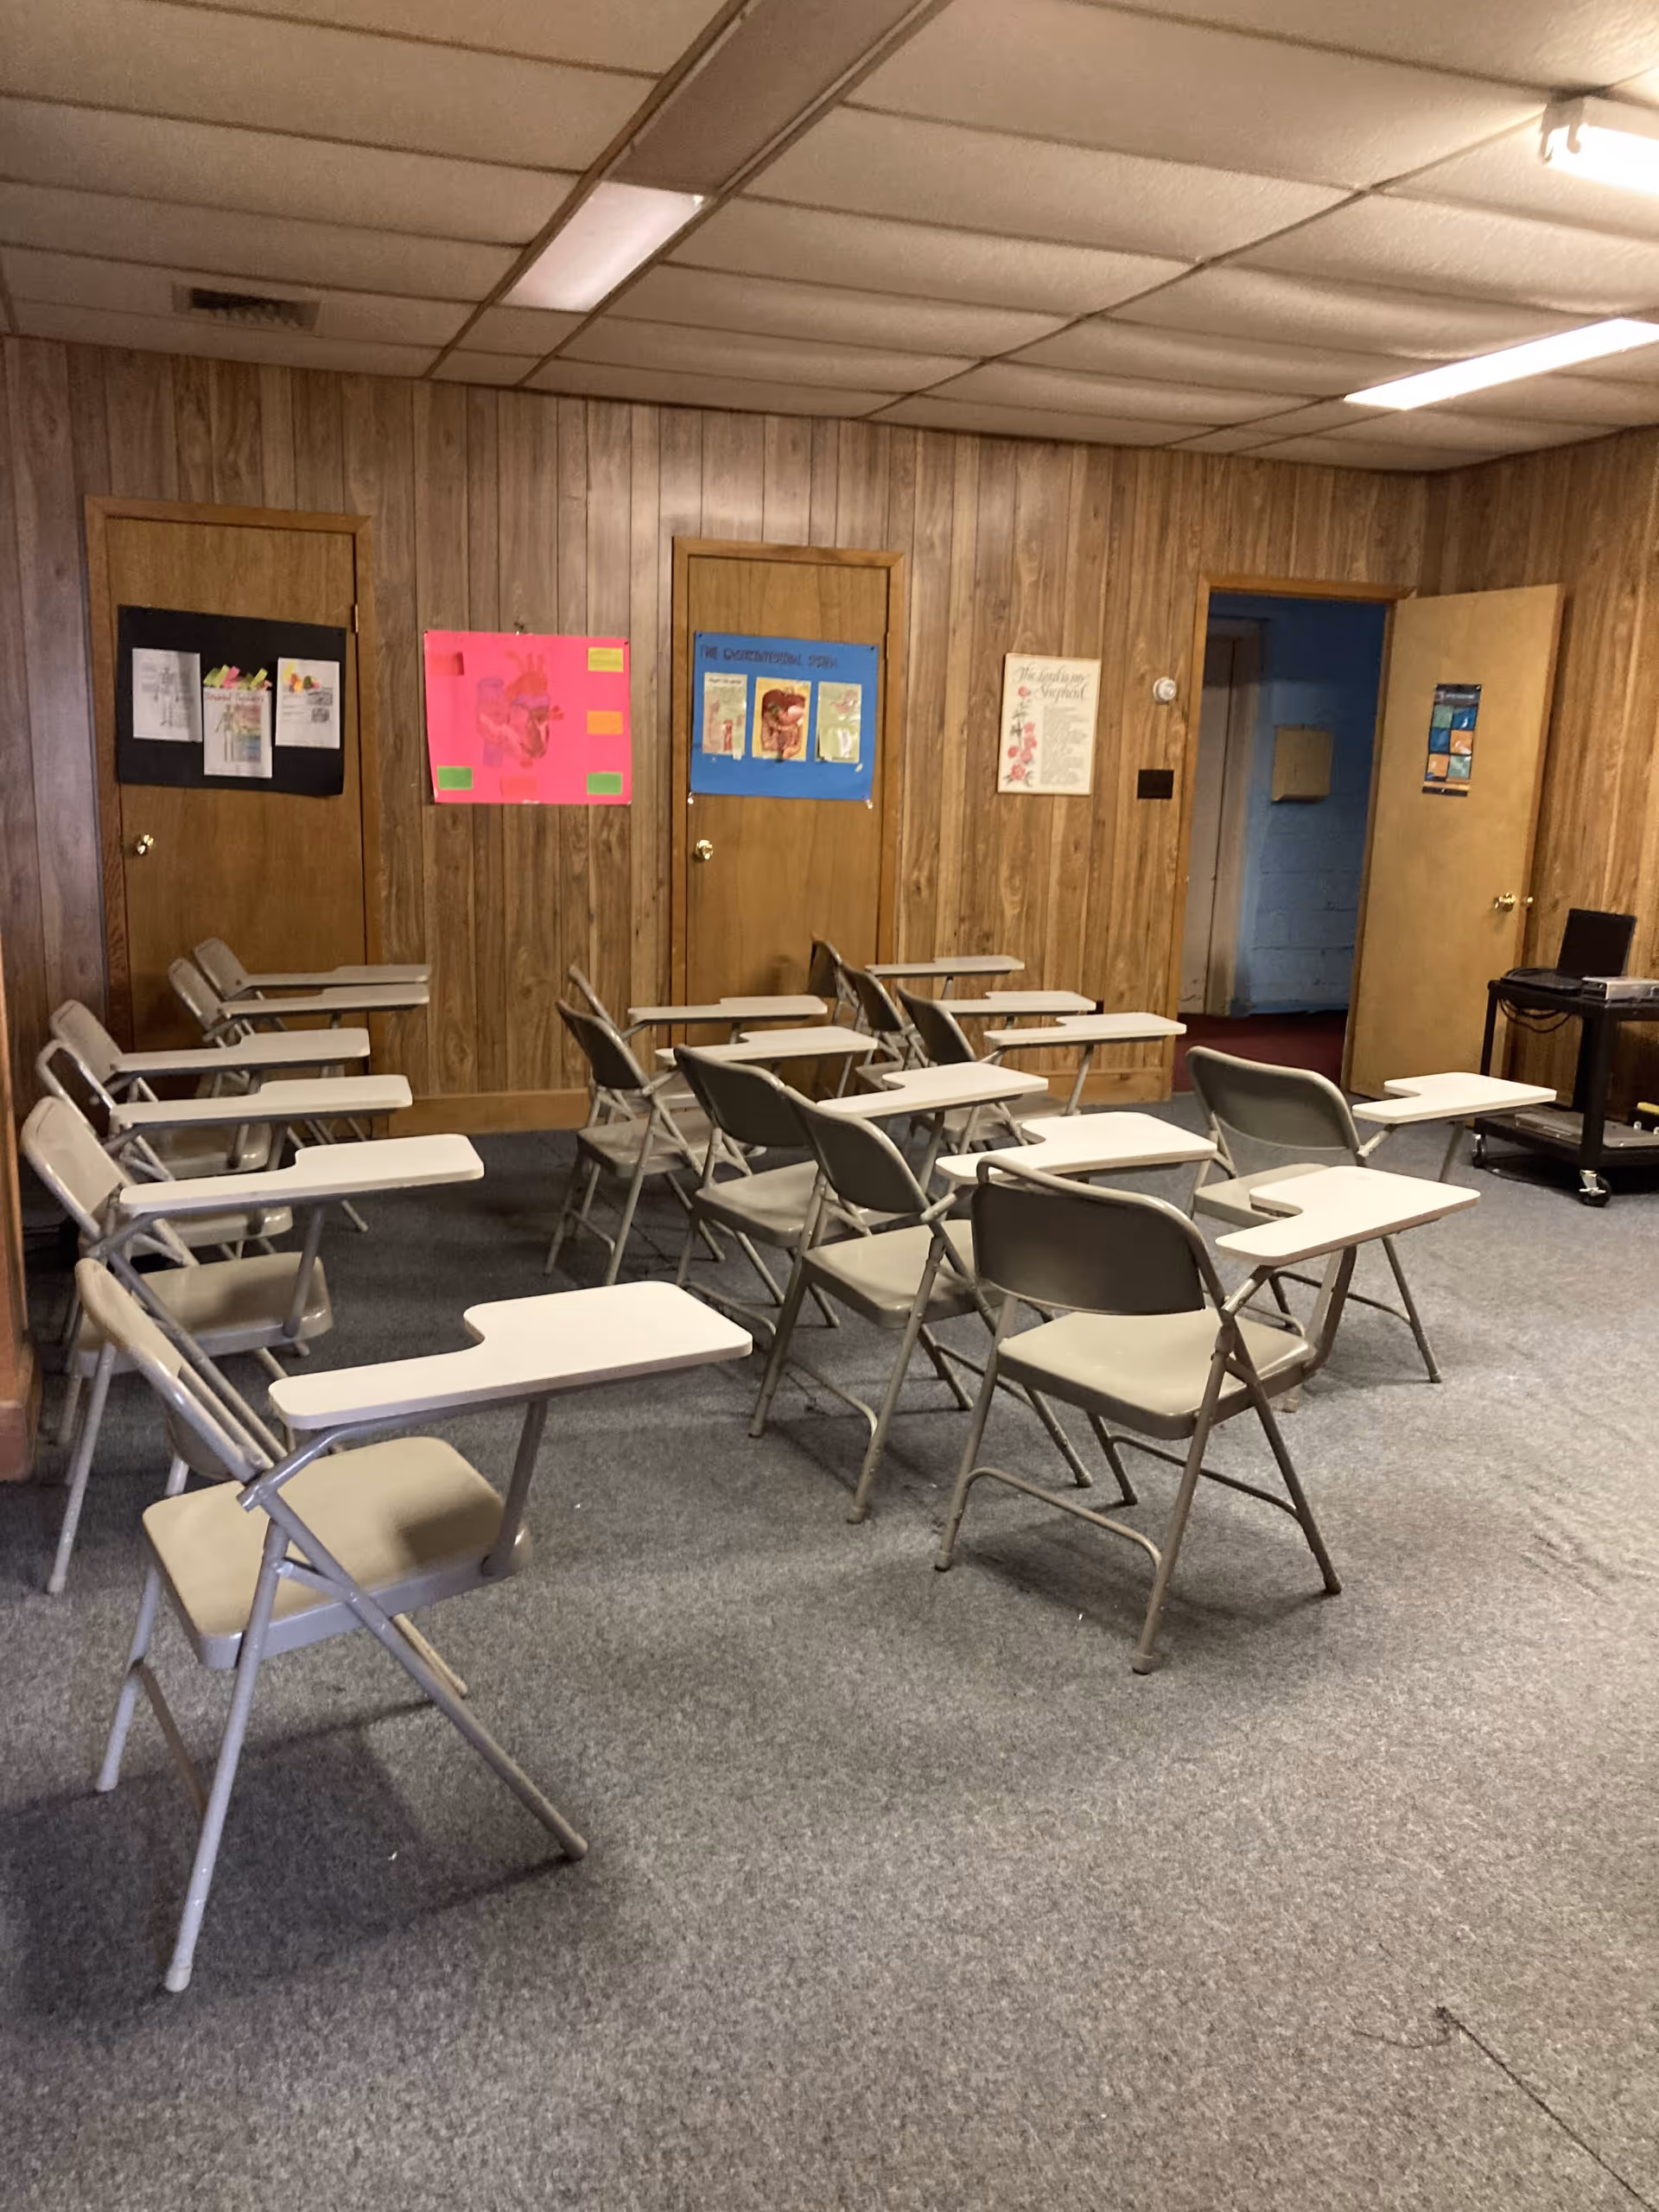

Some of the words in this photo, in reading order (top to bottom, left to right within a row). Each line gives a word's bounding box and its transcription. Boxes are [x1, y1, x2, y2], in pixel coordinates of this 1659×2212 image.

[1013, 663, 1036, 683] The
[1038, 665, 1063, 683] Lord
[1070, 672, 1086, 684] my
[1040, 682, 1087, 703] Shepherd
